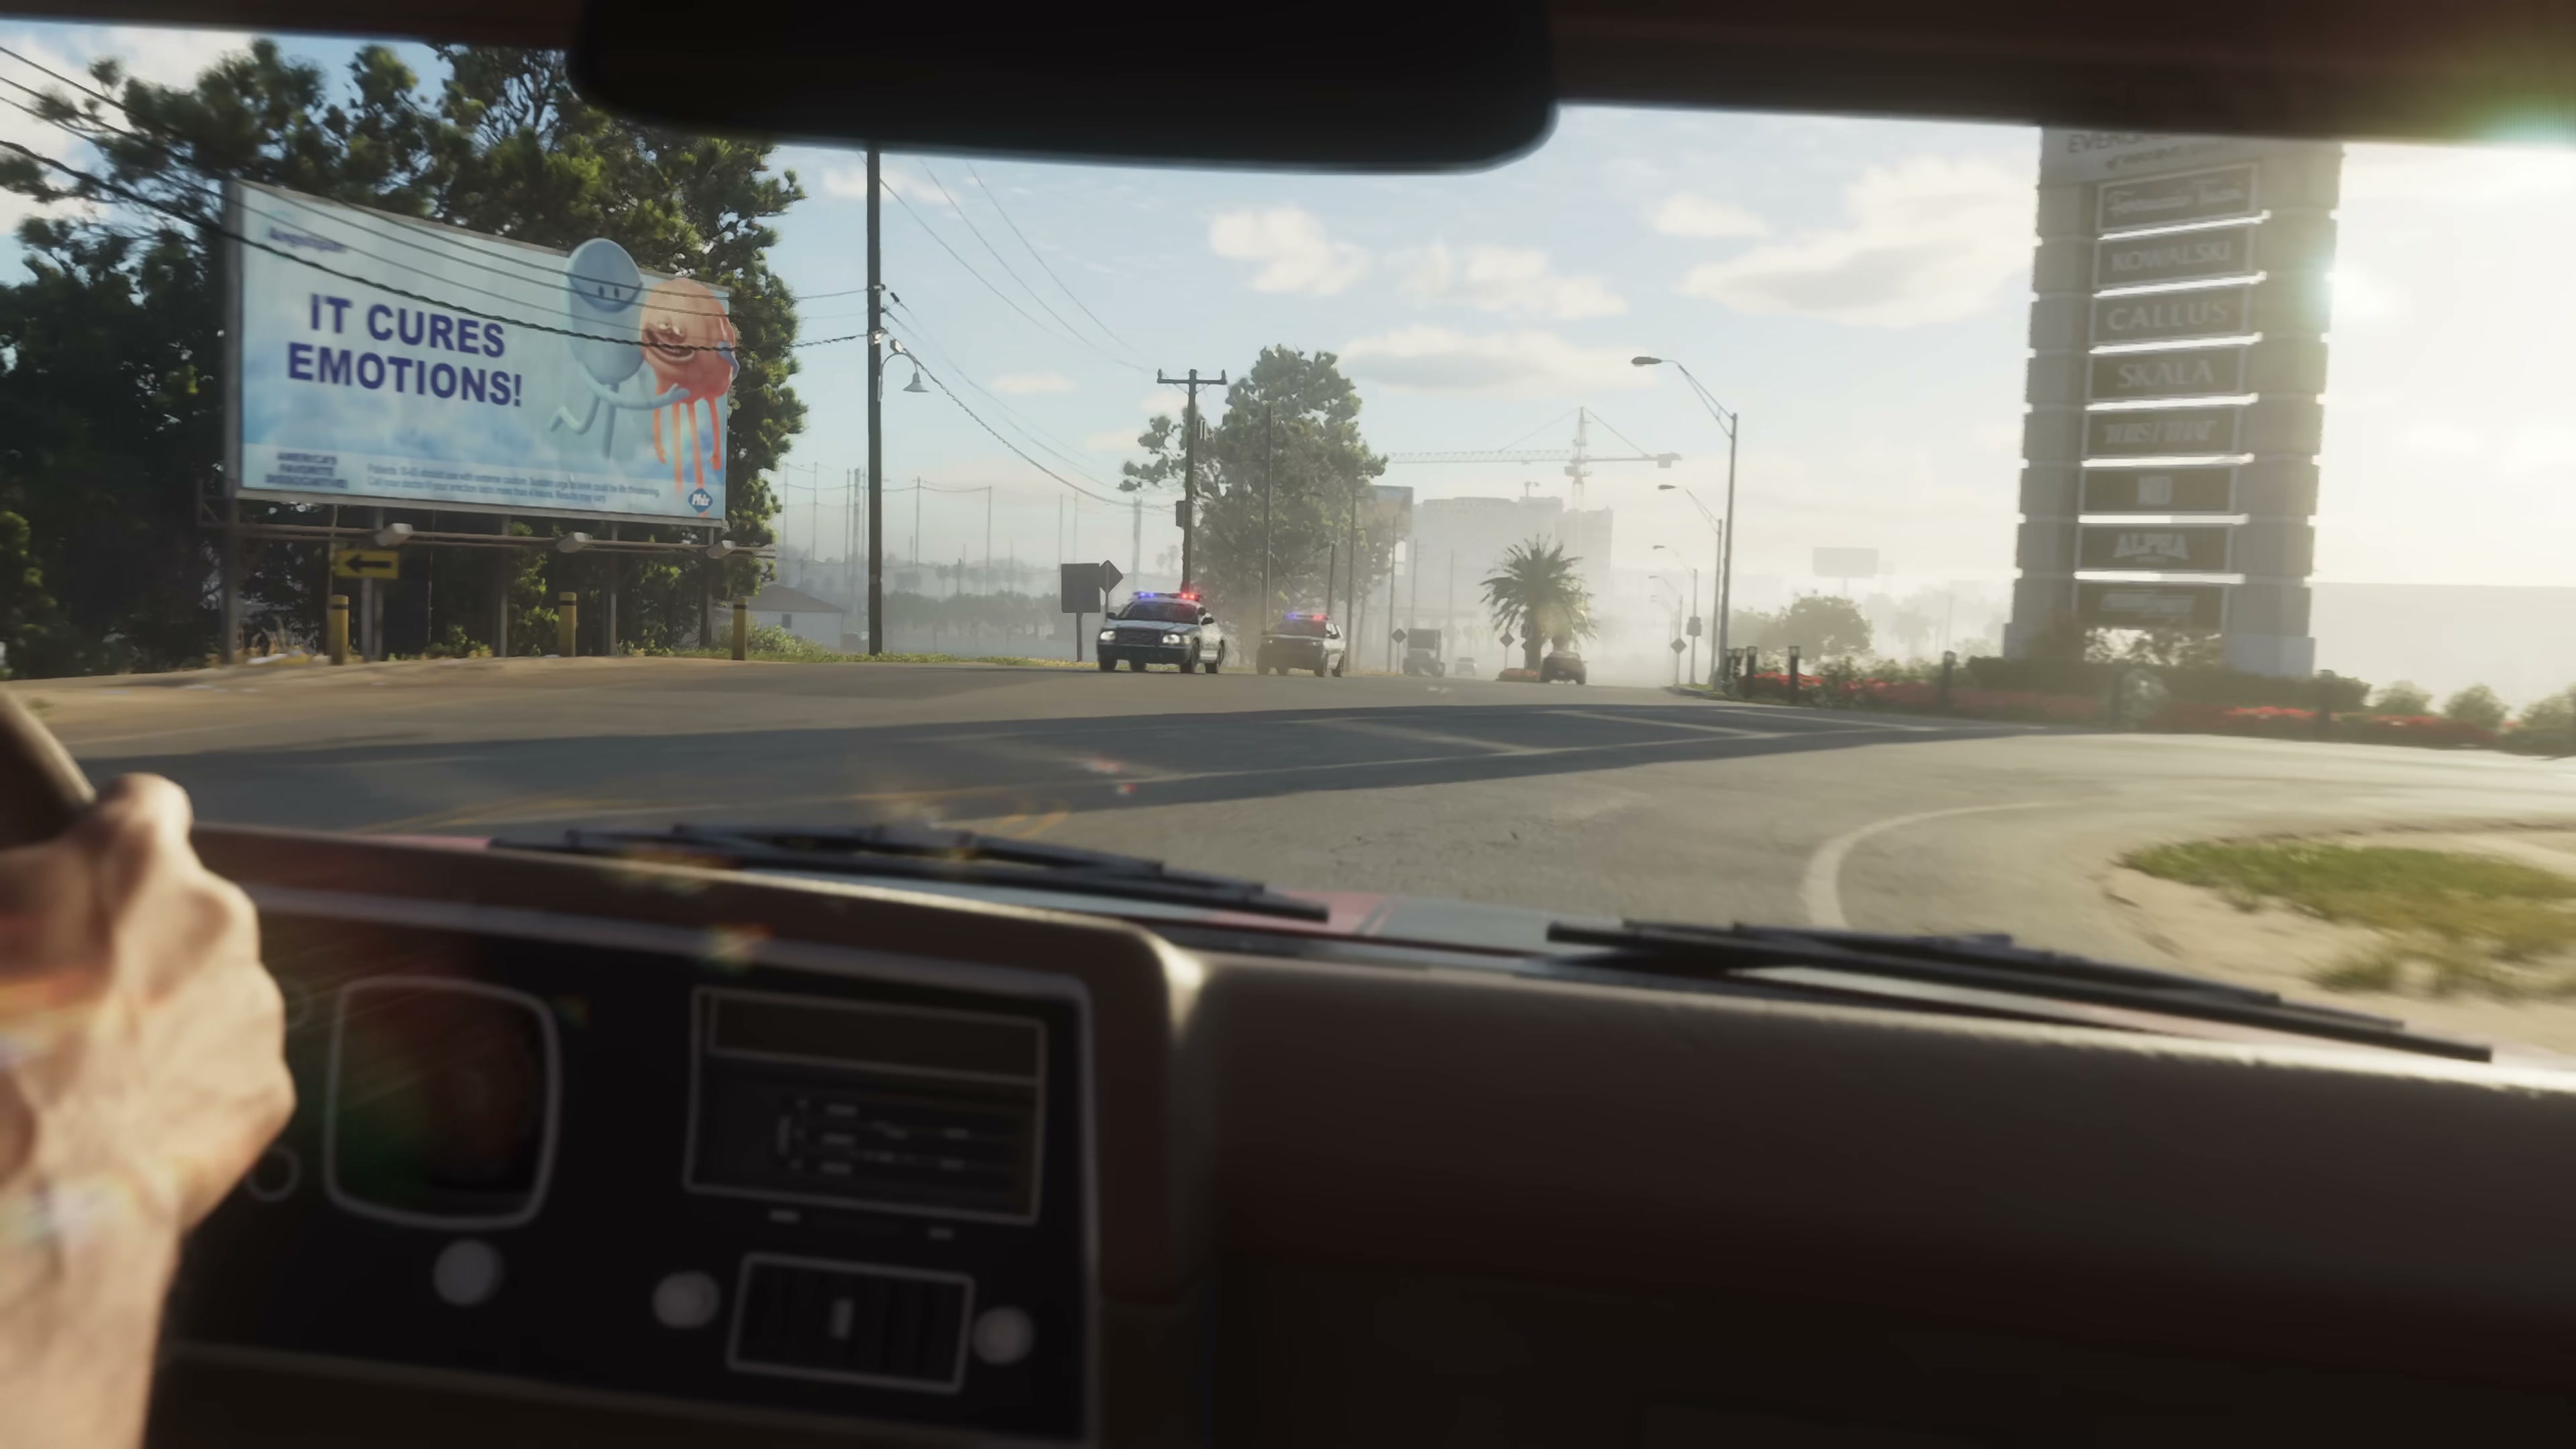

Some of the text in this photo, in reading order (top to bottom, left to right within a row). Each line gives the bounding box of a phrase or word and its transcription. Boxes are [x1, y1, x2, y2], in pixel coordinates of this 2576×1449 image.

[2111, 241, 2231, 271] KOWALSKI
[311, 292, 506, 358] IT CURES
[2106, 301, 2229, 331] CALLUS
[288, 341, 523, 407] EMOTIONS!
[2117, 360, 2213, 389] SKALA
[2113, 533, 2190, 561] ALPHA
